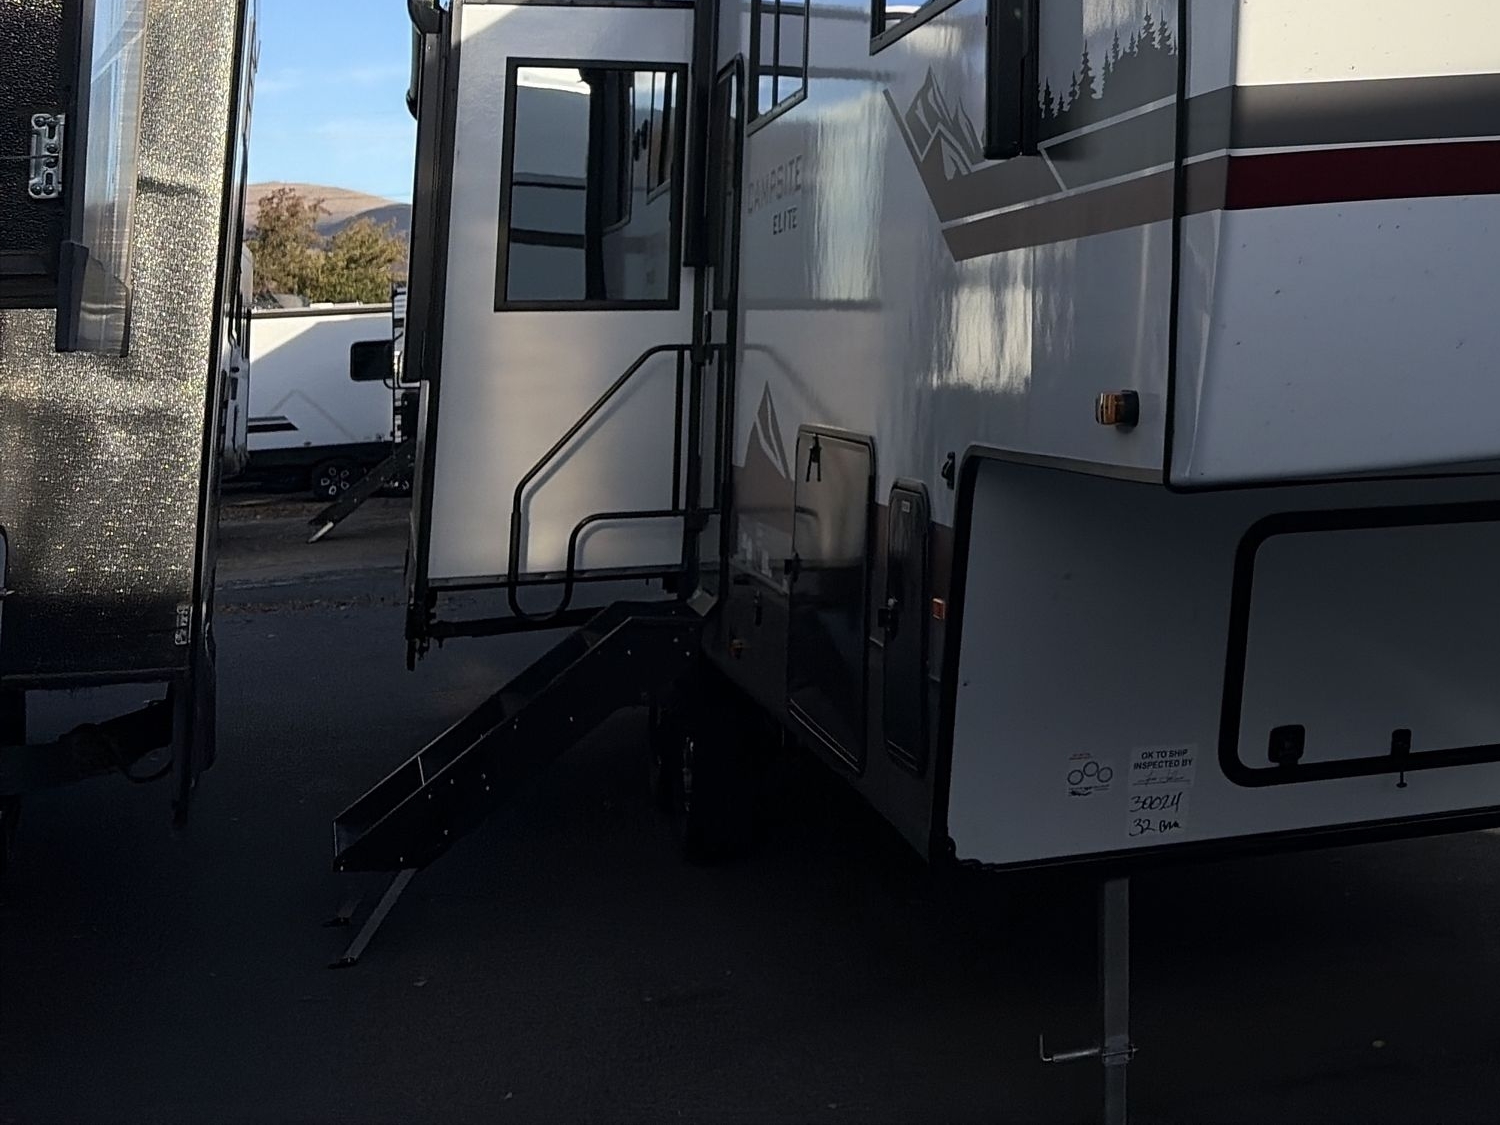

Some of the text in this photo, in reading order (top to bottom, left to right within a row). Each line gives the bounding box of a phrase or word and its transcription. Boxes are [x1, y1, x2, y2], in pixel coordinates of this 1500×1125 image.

[747, 154, 803, 215] CAMPSITE
[772, 207, 798, 236] ELITE
[1141, 748, 1189, 760] OK TO SHIP
[1133, 758, 1193, 770] INSPECTED BY
[1129, 818, 1155, 837] 32
